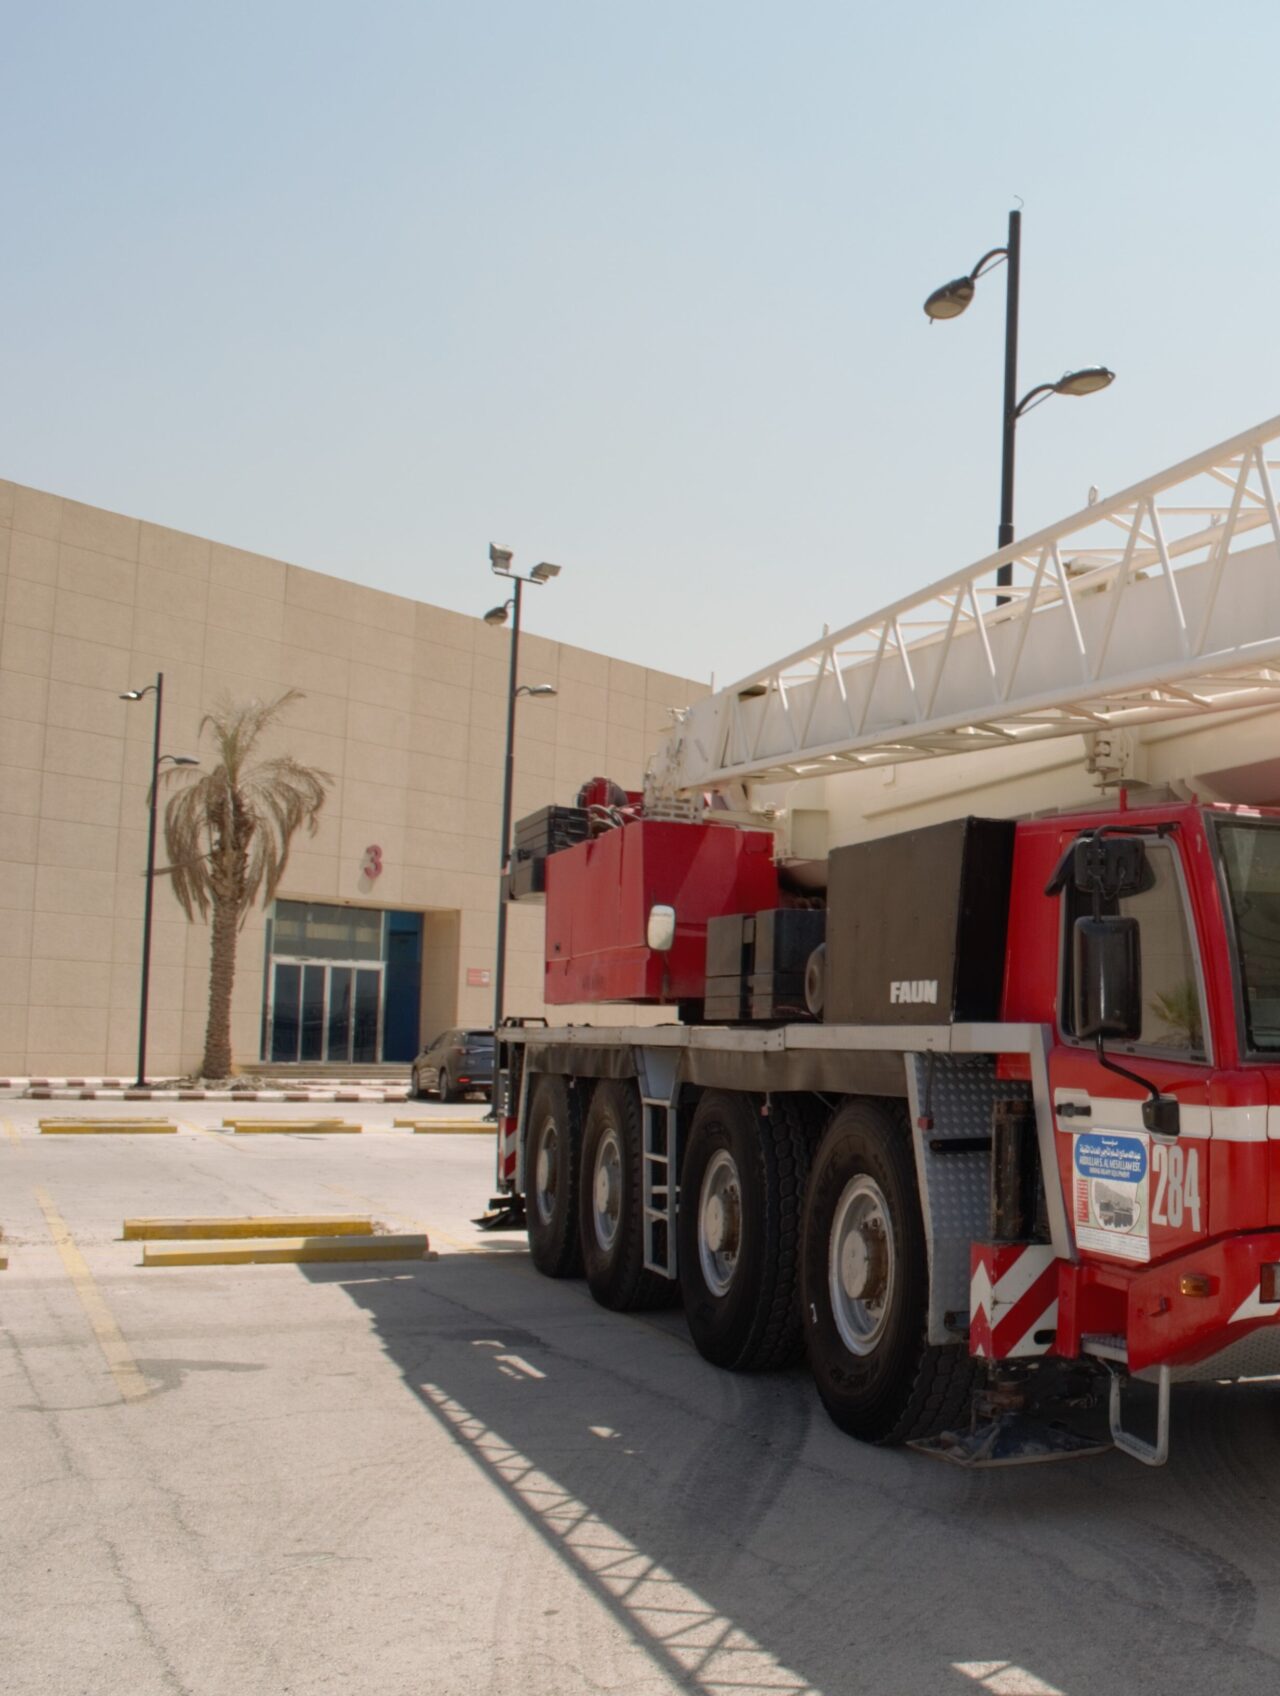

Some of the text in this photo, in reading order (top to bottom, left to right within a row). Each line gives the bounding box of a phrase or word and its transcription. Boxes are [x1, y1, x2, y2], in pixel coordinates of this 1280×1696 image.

[364, 845, 382, 879] 3
[890, 980, 938, 1004] FAUN
[1152, 1144, 1201, 1232] 284
